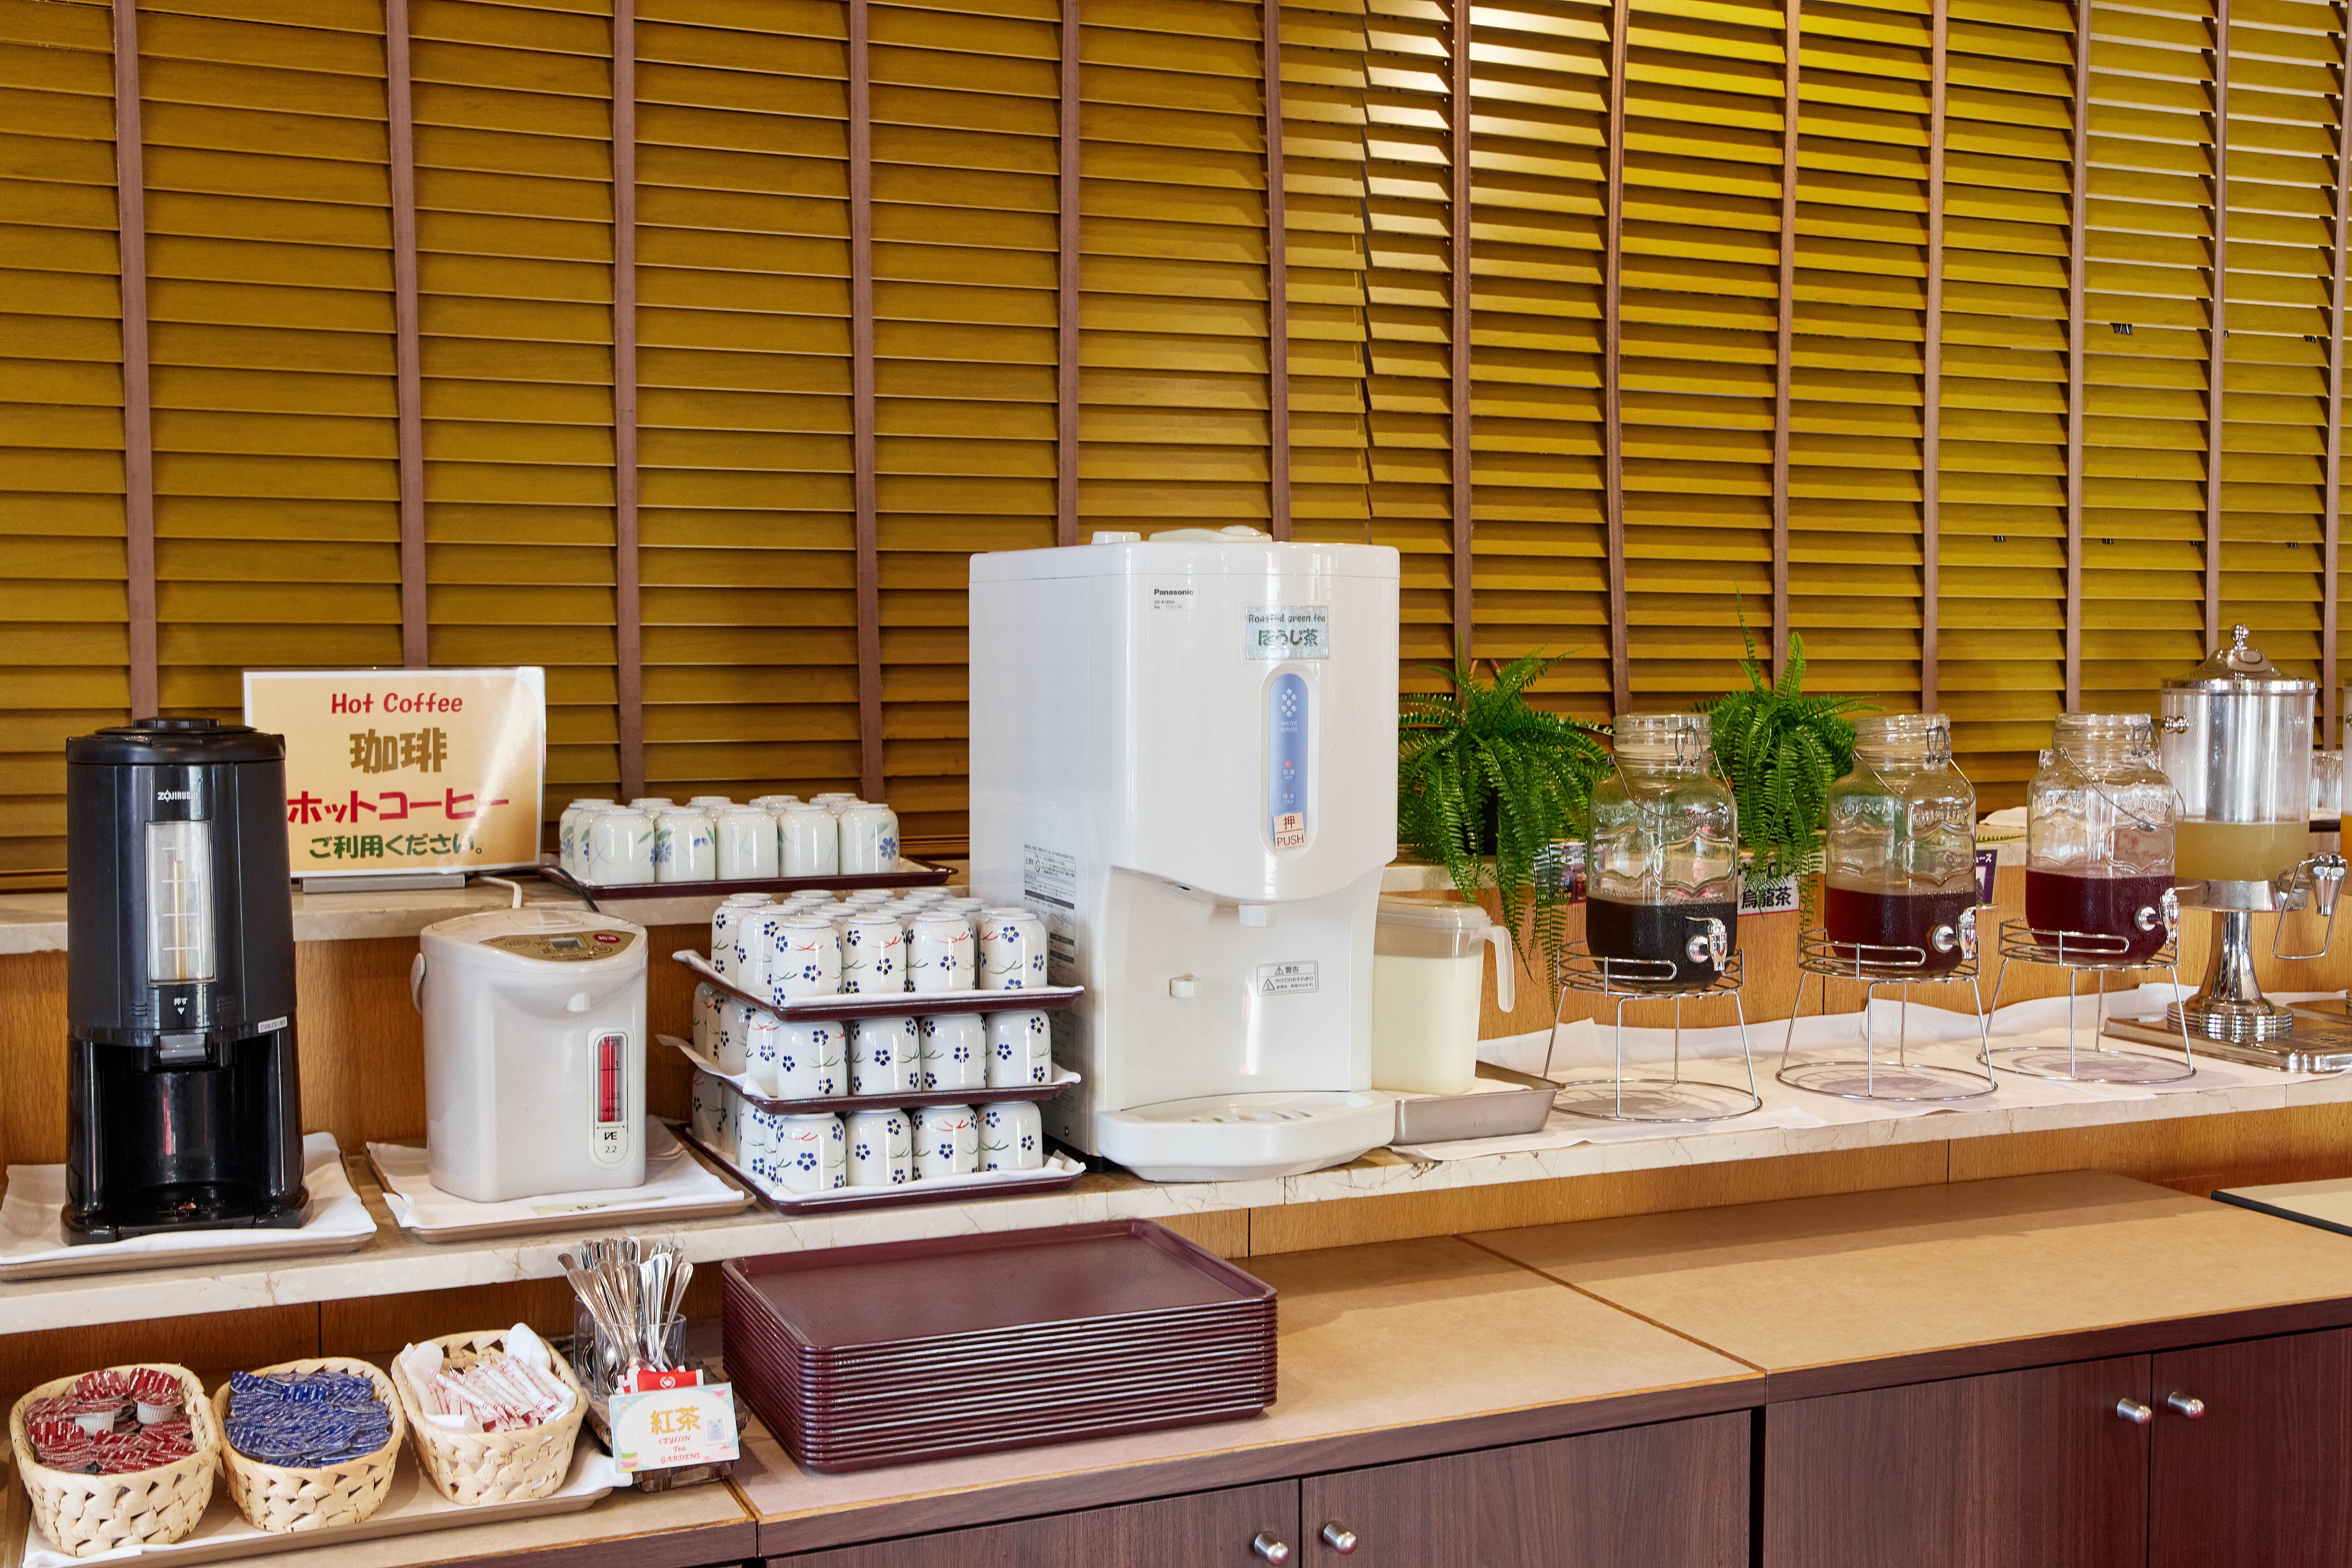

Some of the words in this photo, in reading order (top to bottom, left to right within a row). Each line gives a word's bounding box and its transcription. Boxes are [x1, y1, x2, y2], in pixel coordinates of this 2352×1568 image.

[1248, 614, 1285, 623] Roasted
[1287, 615, 1311, 623] green
[1314, 613, 1325, 622] tea
[1258, 628, 1318, 647] ほうじ茶
[332, 693, 374, 714] Hot
[383, 692, 463, 713] Coffee
[350, 727, 447, 775] 珈琲
[158, 789, 198, 802] ZOJIRUSHI
[287, 788, 509, 825] ホットコーヒー
[1283, 815, 1295, 830] 押
[309, 833, 482, 860] ご利用ください。
[1277, 834, 1304, 847] PUSH
[260, 1021, 277, 1031] STAINLESS
[650, 1406, 701, 1435] 紅茶
[659, 1435, 691, 1445] CEYLON
[660, 1453, 700, 1464] GARDENS
